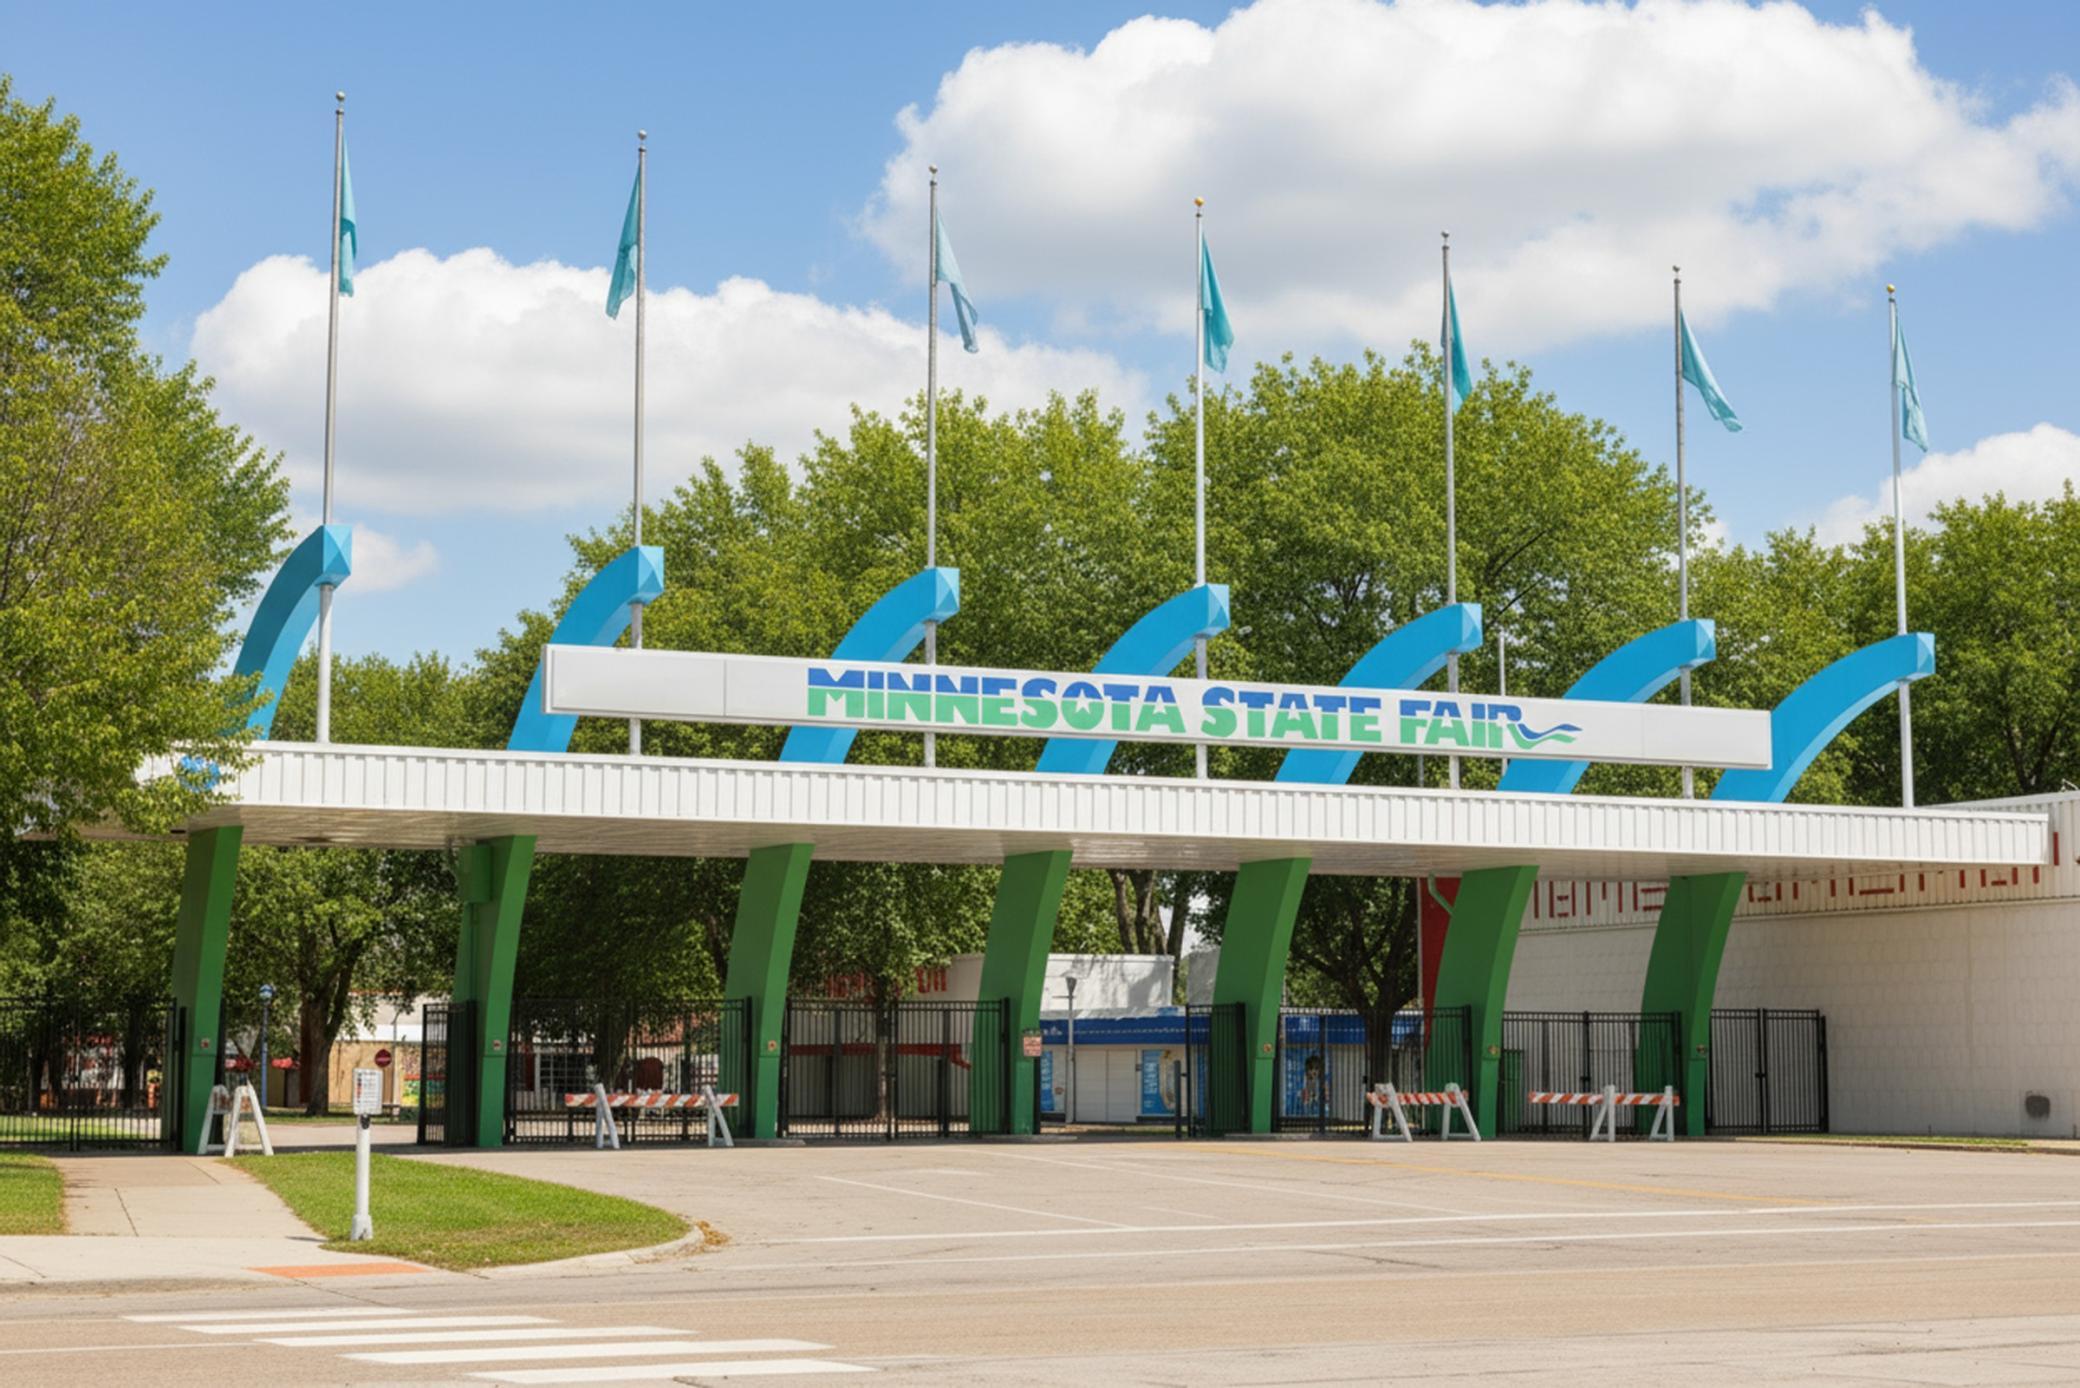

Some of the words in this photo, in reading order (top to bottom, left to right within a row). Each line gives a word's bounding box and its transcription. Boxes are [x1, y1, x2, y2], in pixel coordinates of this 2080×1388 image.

[808, 667, 1186, 733] MINNESOTA
[1201, 686, 1382, 743] STATE
[1400, 699, 1543, 749] FAIR
